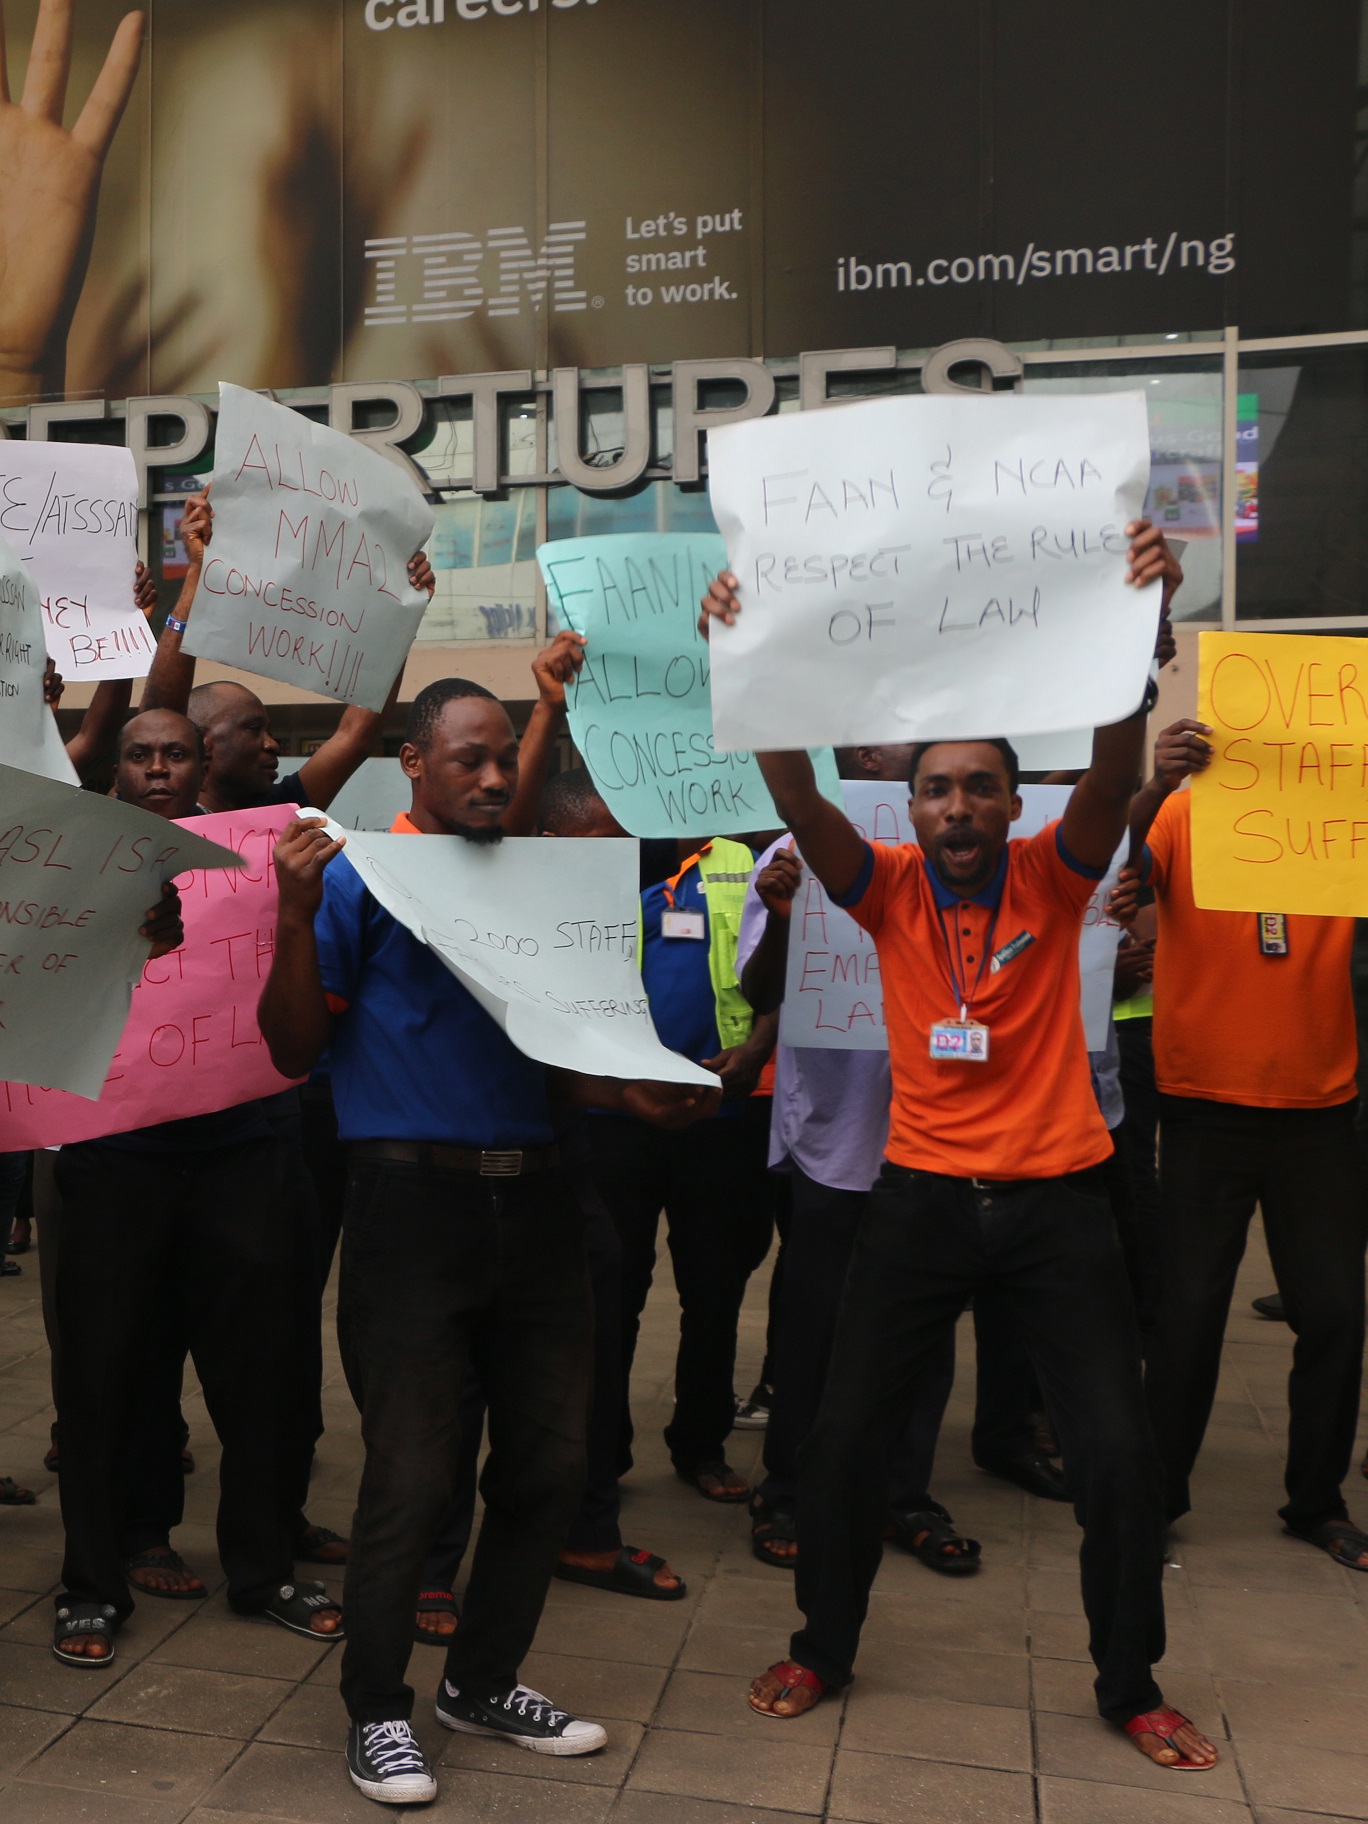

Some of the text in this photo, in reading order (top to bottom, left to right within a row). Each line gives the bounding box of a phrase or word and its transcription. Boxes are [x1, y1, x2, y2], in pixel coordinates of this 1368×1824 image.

[364, 0, 599, 31] care.
[625, 207, 743, 240] Let's put
[625, 245, 707, 273] smart
[836, 232, 1236, 292] ibm.com/smart/ng
[625, 275, 739, 306] to work.
[234, 432, 360, 508] ALLOW
[762, 443, 1103, 528] FAAN & NCAA
[274, 509, 403, 603] MMA2
[754, 522, 1128, 595] RESPECT THE RULE
[203, 558, 366, 634] CONCESSION
[828, 585, 1042, 648] OF LAW
[1209, 652, 1368, 732] OVER
[656, 779, 758, 825] WORK
[42, 952, 80, 975] OF
[209, 928, 277, 981] TH
[454, 918, 540, 958] 2000
[148, 1014, 213, 1068] OF
[65, 1617, 106, 1631] YES
[302, 1594, 331, 1608] NO
